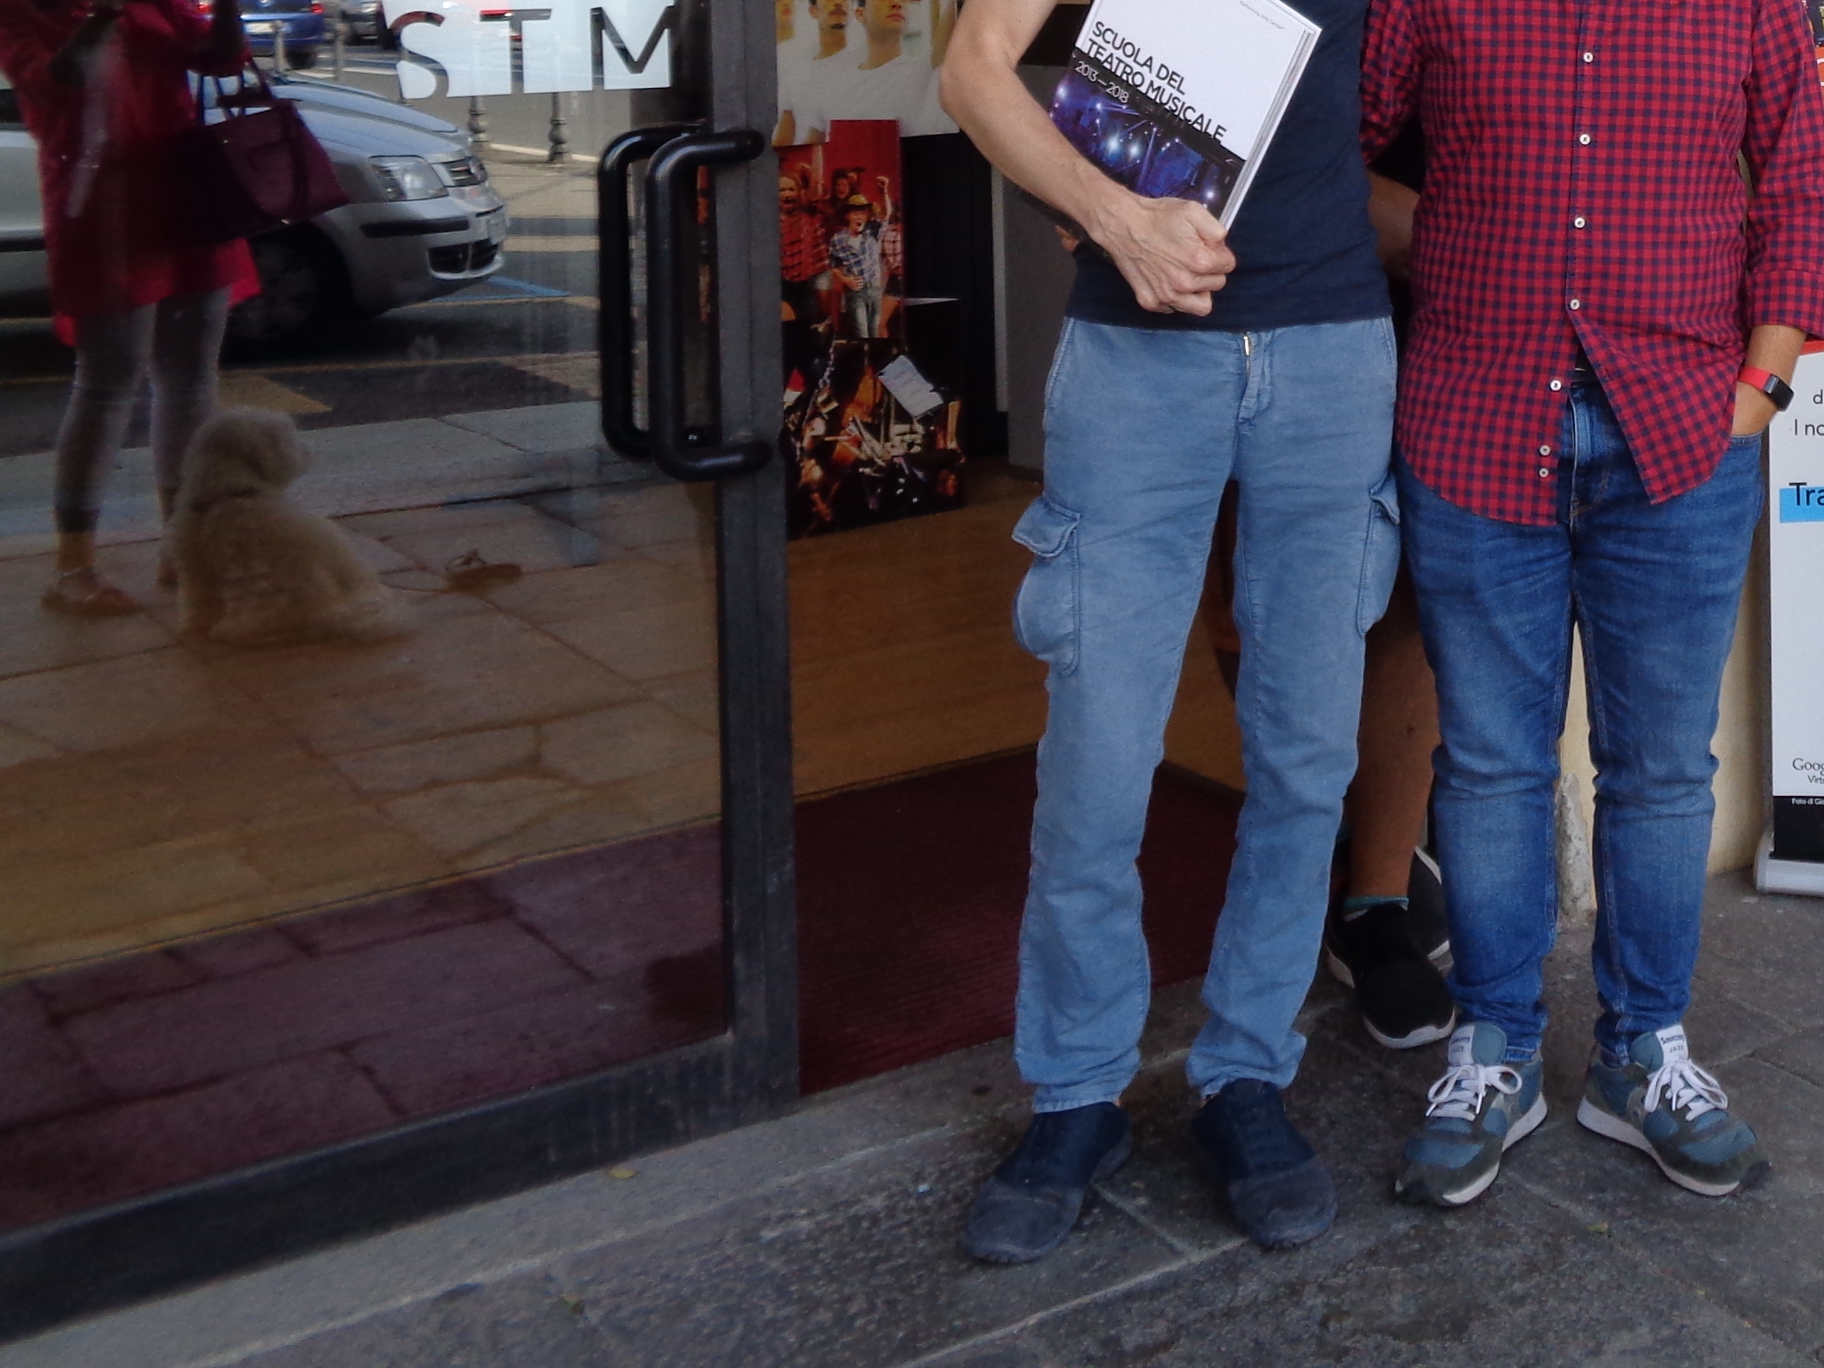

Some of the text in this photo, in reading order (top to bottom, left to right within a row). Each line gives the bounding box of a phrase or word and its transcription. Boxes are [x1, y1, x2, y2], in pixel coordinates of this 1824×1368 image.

[390, 6, 677, 99] STM
[1086, 38, 1227, 145] TEATRO MUSICALE
[1092, 21, 1187, 96] SCUOLA DEL
[1794, 419, 1798, 436] I
